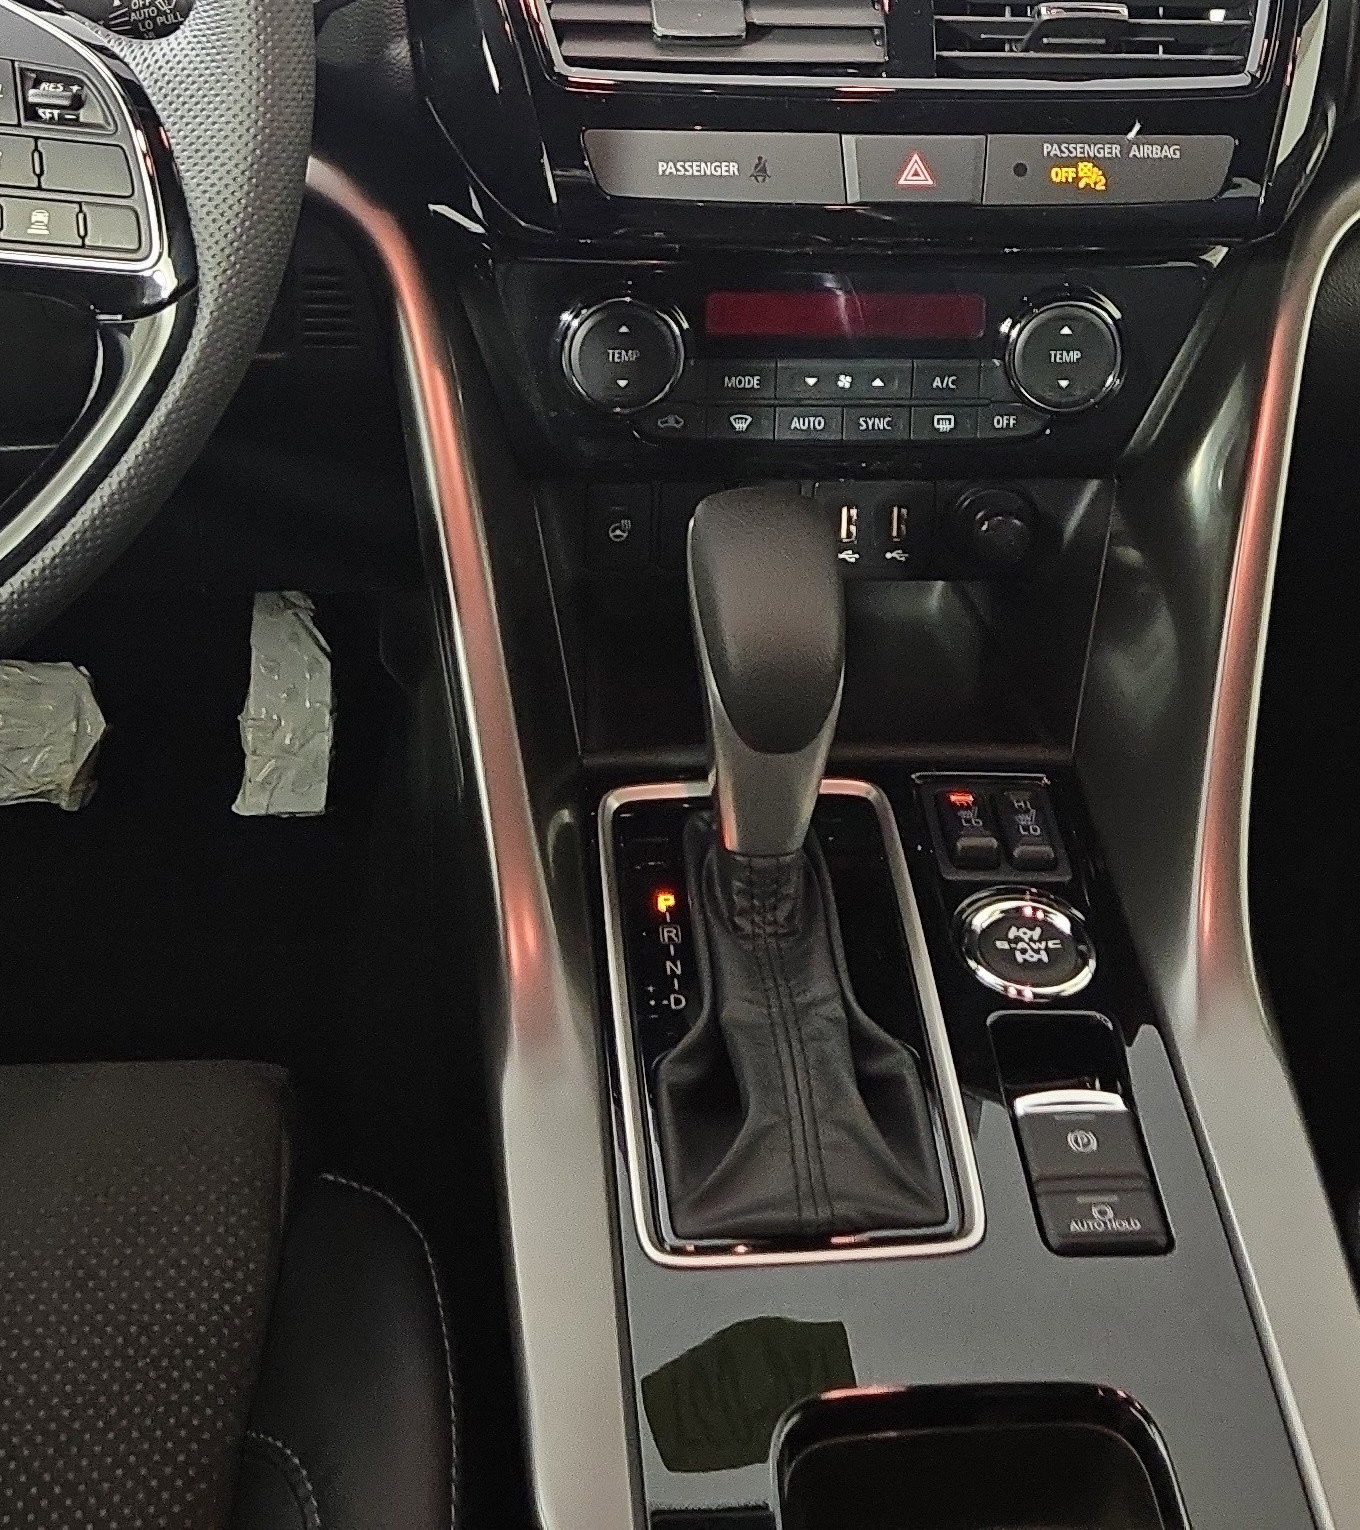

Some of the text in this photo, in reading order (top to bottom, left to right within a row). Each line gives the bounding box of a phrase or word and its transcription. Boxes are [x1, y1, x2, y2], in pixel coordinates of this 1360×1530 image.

[130, 6, 157, 21] AUTO
[156, 12, 184, 26] PULL
[140, 20, 154, 32] LO
[40, 82, 64, 91] RES
[1043, 143, 1181, 159] PASSENGER AIRBAG
[658, 161, 740, 176] PASSENGER
[1050, 168, 1076, 182] OFF
[607, 349, 640, 363] TEMP
[1049, 350, 1082, 363] TEMP
[724, 376, 761, 389] MODE
[932, 376, 957, 389] A/C
[791, 417, 825, 430] AUTO
[859, 417, 892, 430] SYNC
[994, 416, 1016, 429] OFF
[1019, 825, 1040, 836] LO
[658, 894, 675, 912] P
[664, 928, 678, 942] R
[666, 960, 682, 975] N
[670, 994, 686, 1009] D
[1070, 1217, 1141, 1232] AUTO HOLD
